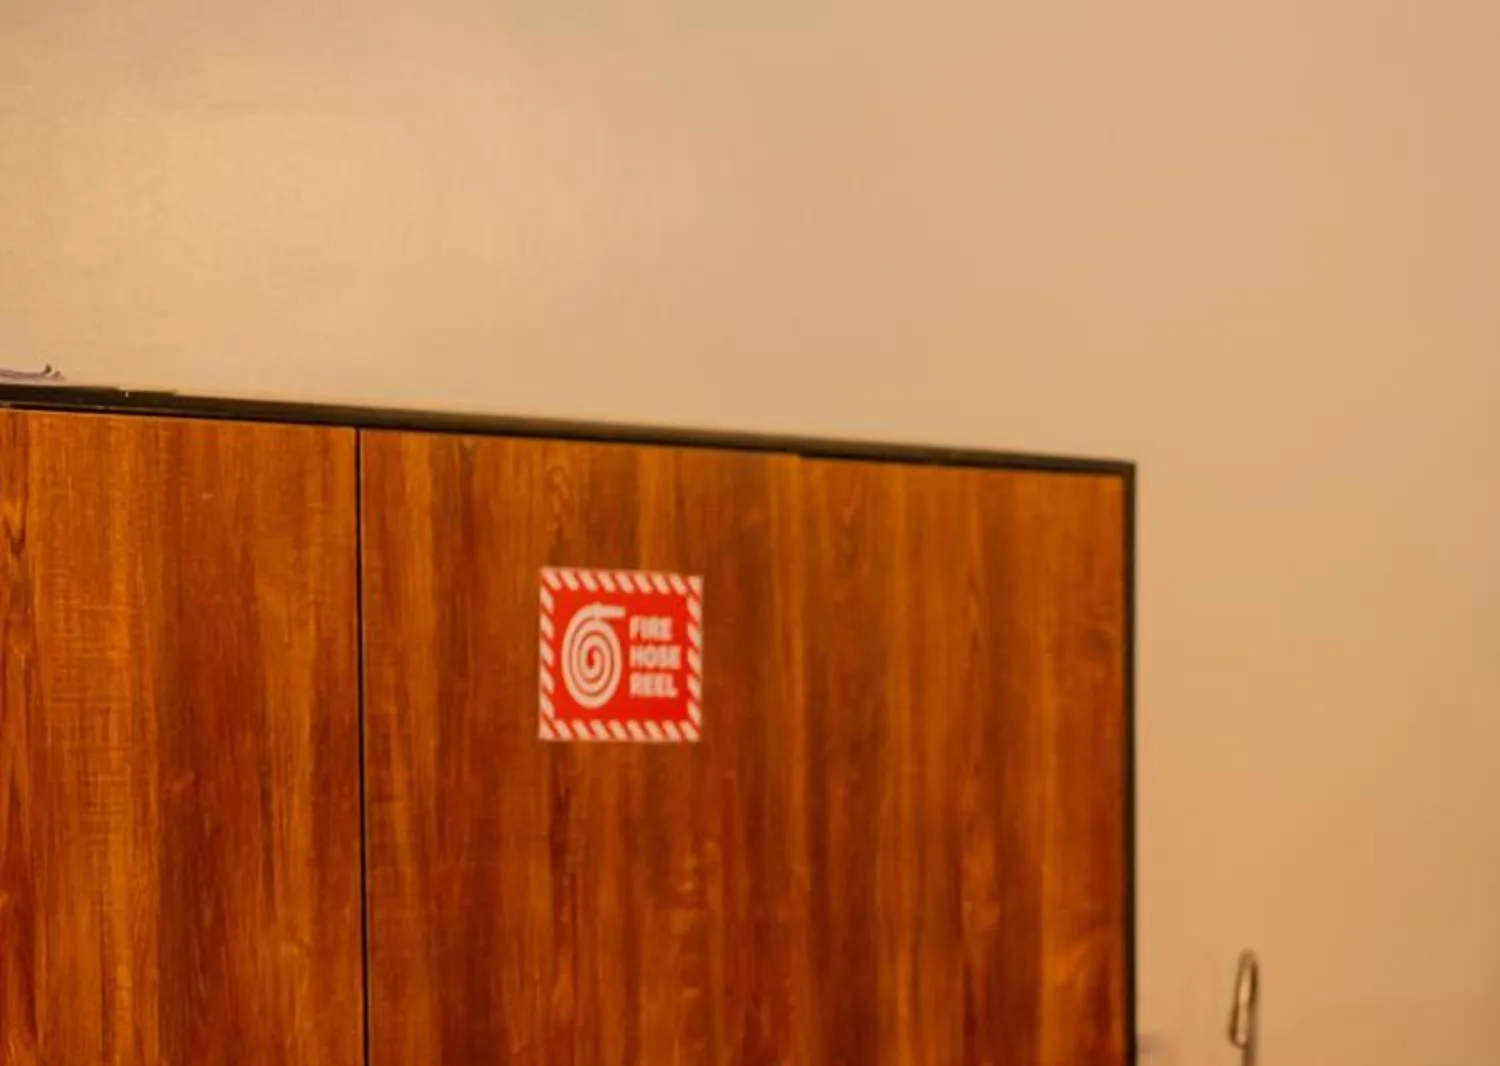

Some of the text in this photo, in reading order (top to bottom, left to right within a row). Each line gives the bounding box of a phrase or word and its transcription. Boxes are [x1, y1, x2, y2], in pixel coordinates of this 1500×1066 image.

[630, 616, 672, 641] FIRE
[630, 644, 681, 670] HOSE
[630, 672, 678, 697] REEL
